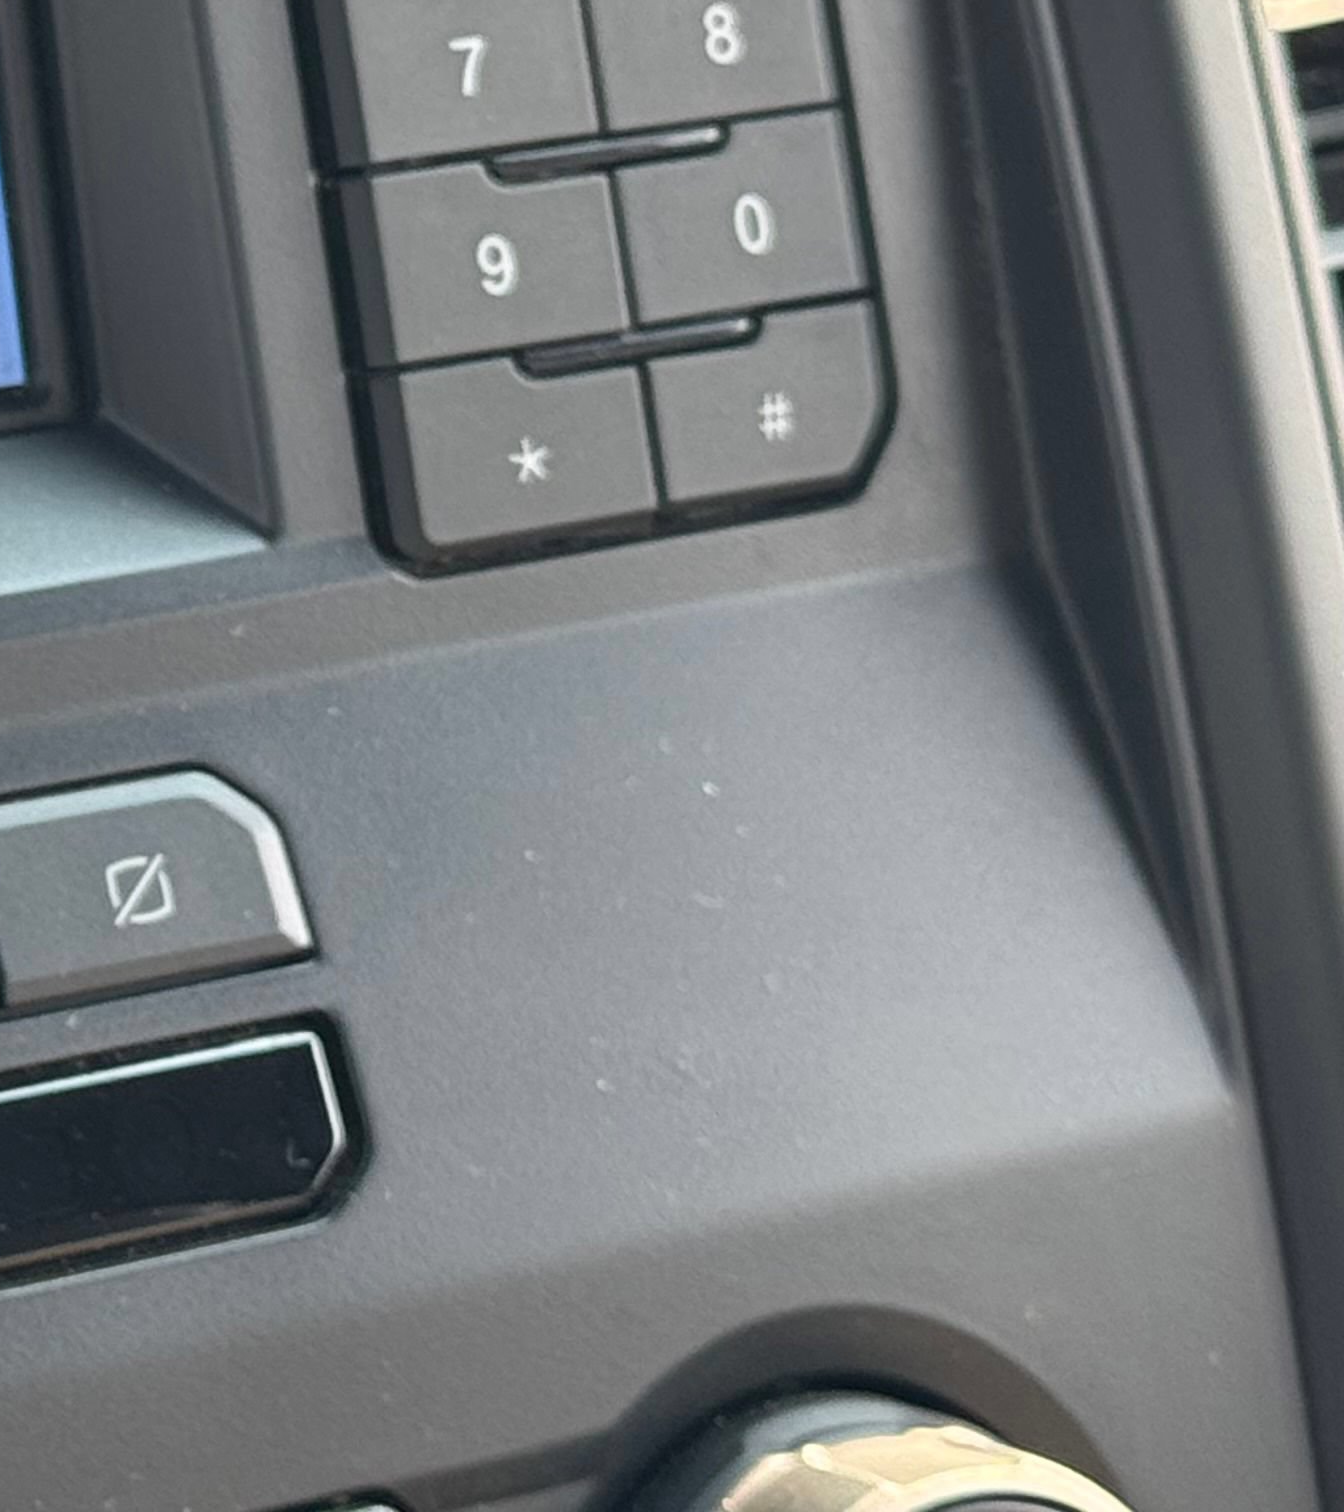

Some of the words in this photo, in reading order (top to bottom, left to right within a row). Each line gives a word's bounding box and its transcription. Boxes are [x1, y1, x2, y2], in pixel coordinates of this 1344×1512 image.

[703, 1, 746, 65] 8
[447, 34, 488, 97] 7
[734, 192, 776, 256] 0
[476, 234, 517, 296] 9
